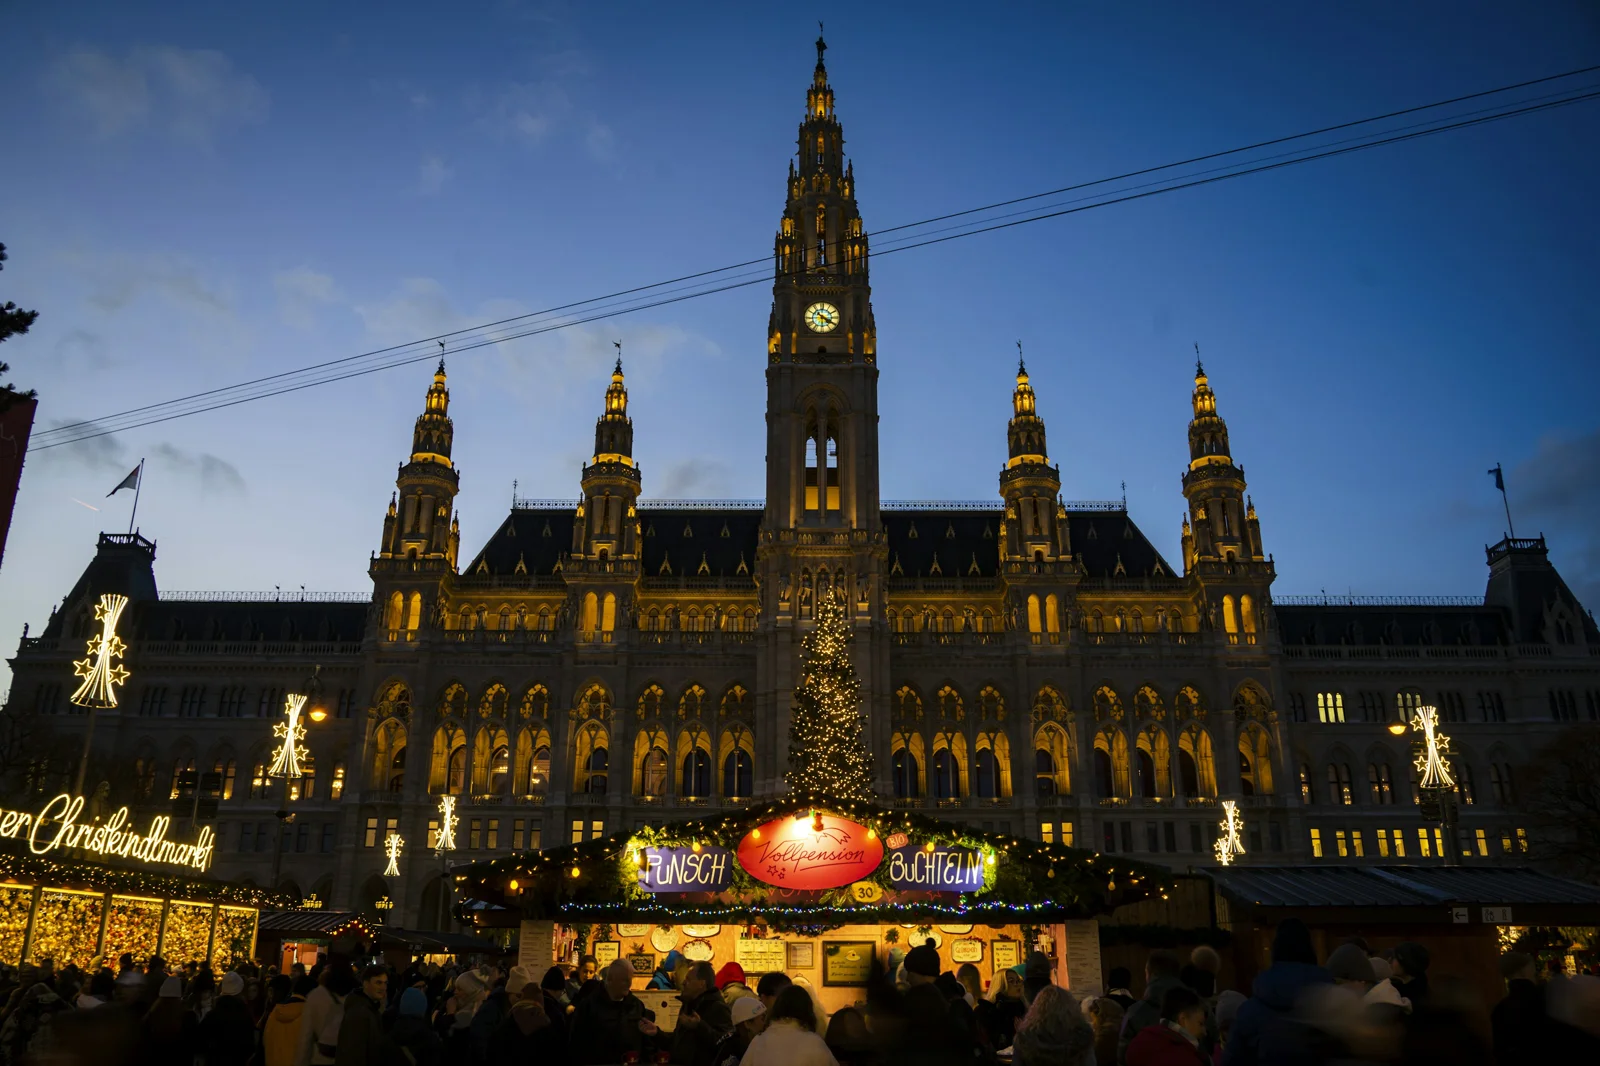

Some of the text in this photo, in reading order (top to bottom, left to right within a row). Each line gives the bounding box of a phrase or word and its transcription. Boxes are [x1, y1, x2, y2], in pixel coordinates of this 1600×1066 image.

[0, 794, 214, 872] er Christkindlmarkt
[889, 834, 905, 848] BIO
[757, 840, 864, 873] Vollpension
[858, 886, 874, 899] 30
